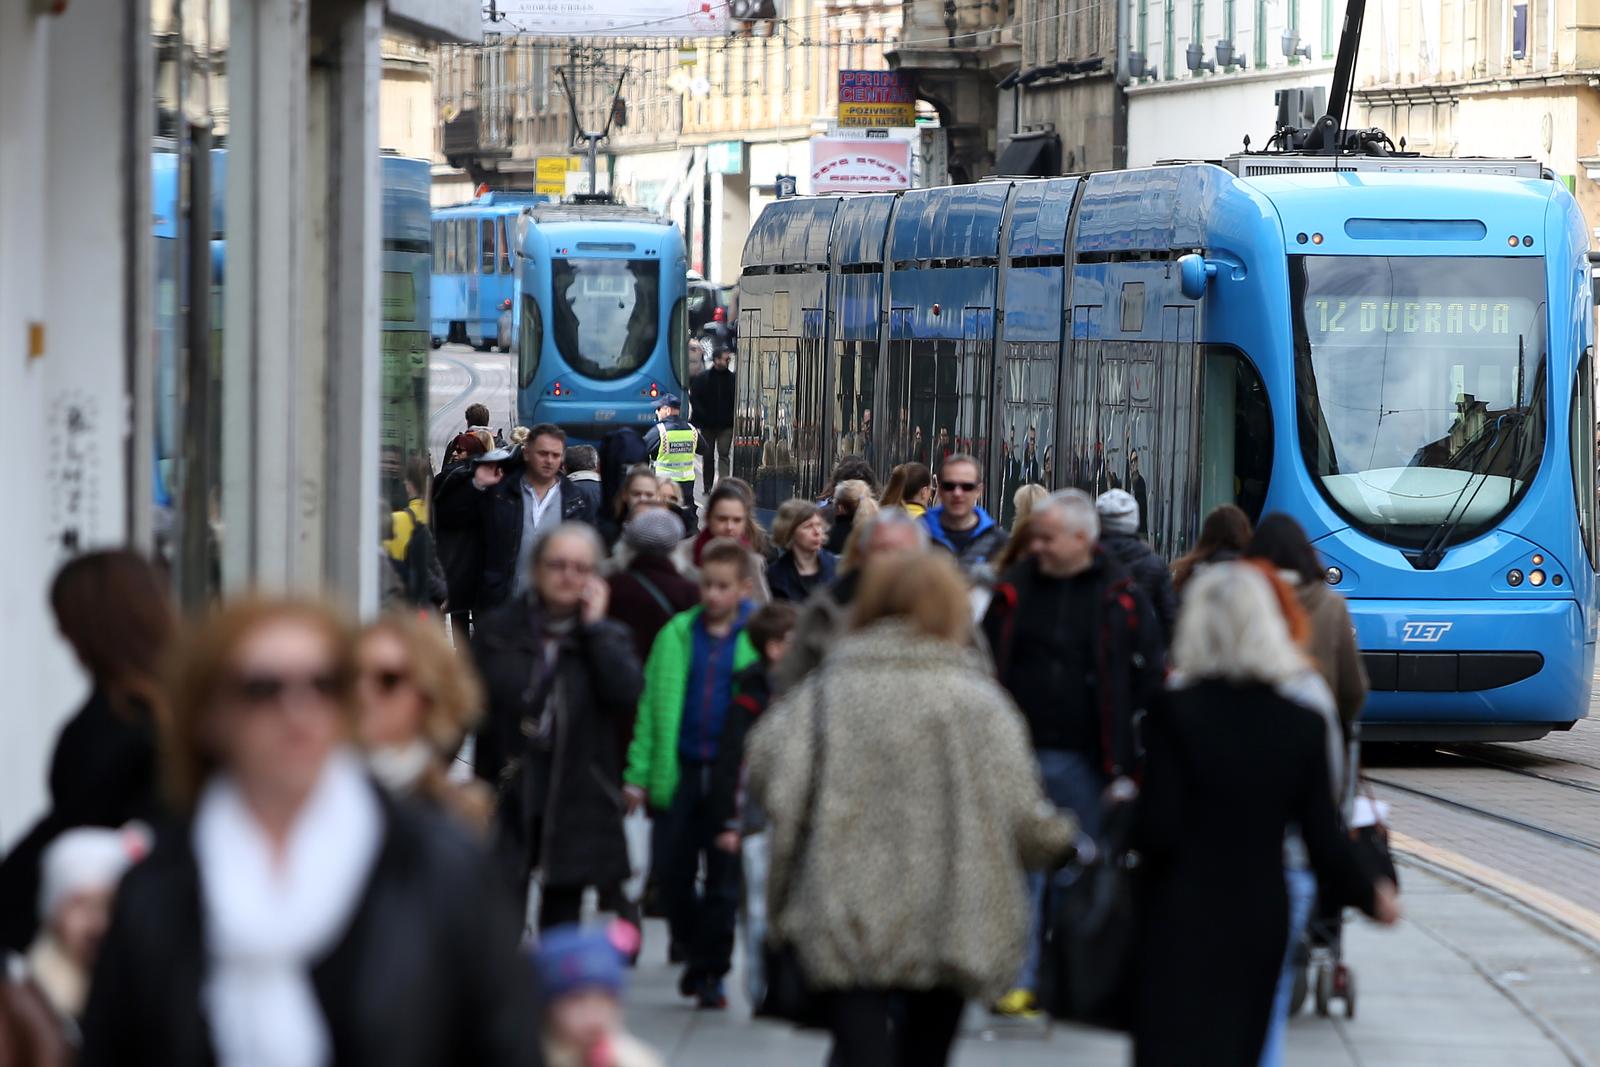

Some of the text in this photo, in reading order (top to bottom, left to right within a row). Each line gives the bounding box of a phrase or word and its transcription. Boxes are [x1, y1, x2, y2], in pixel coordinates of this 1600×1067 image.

[840, 71, 911, 86] PRIN
[1316, 300, 1510, 334] 12 DUBRAVA
[1403, 622, 1453, 642] ZET
